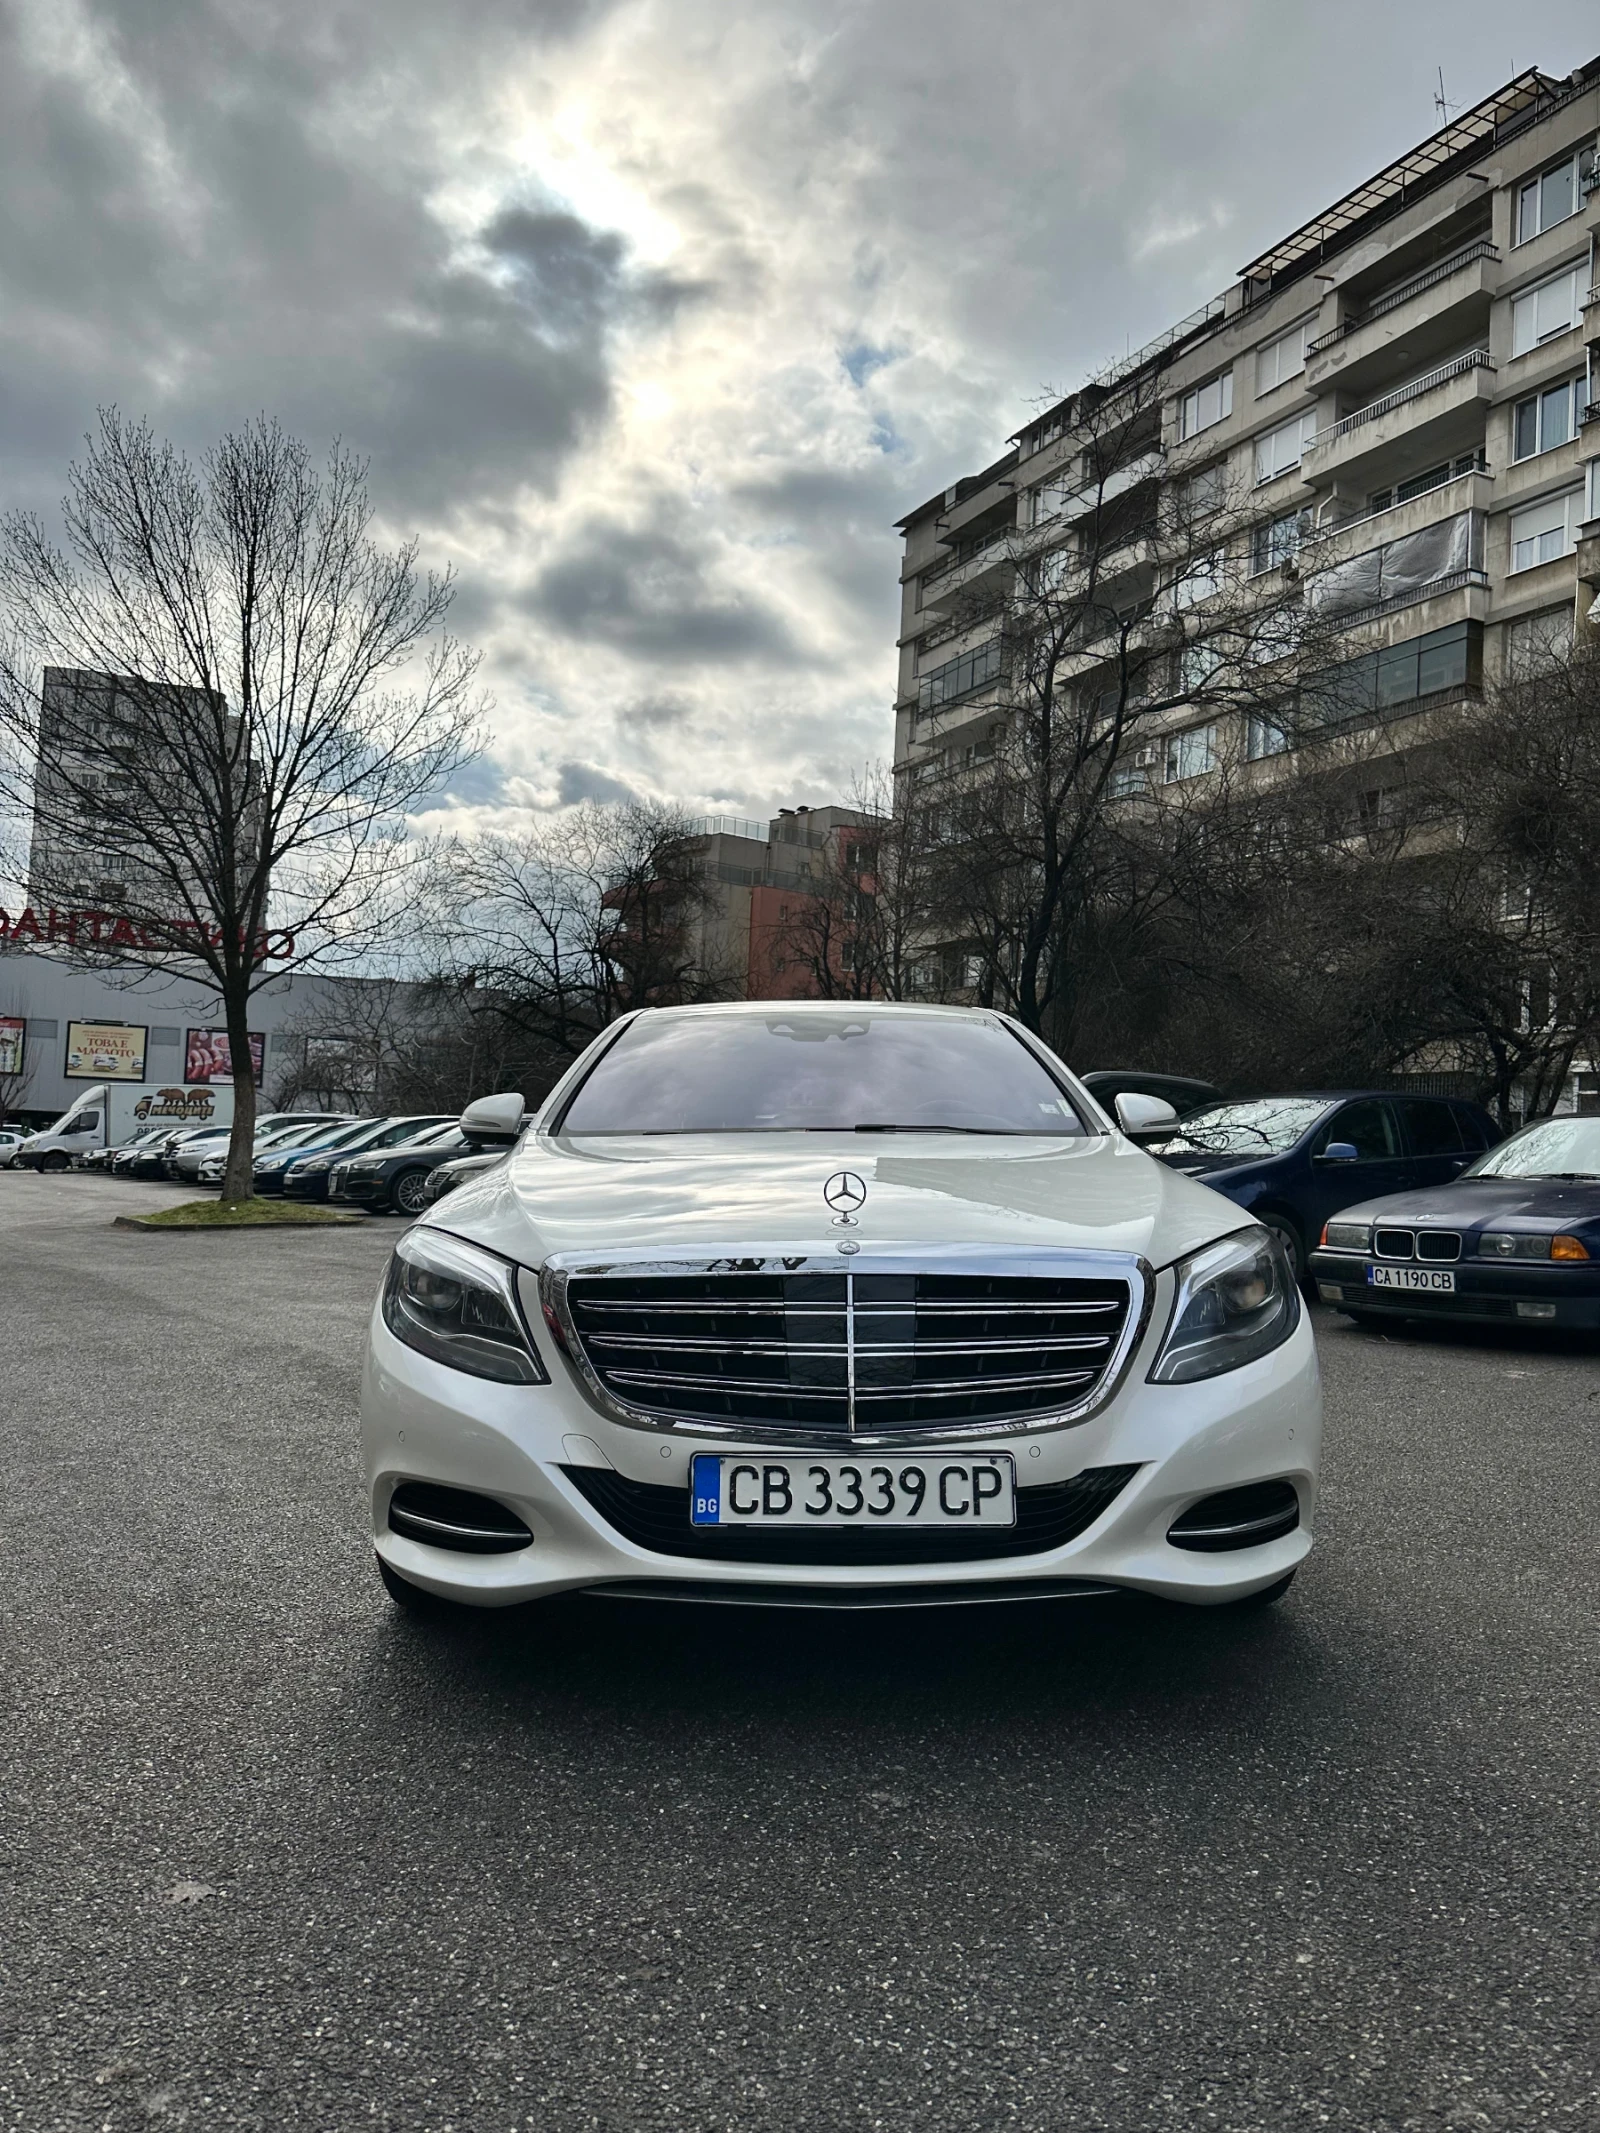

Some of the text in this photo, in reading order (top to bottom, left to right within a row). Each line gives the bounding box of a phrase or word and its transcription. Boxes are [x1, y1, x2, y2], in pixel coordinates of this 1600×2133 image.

[87, 1037, 128, 1048] ТОВА Е
[1374, 1268, 1452, 1289] CA 1190 CB
[696, 1465, 1003, 1516] BG CB 3339 CP
